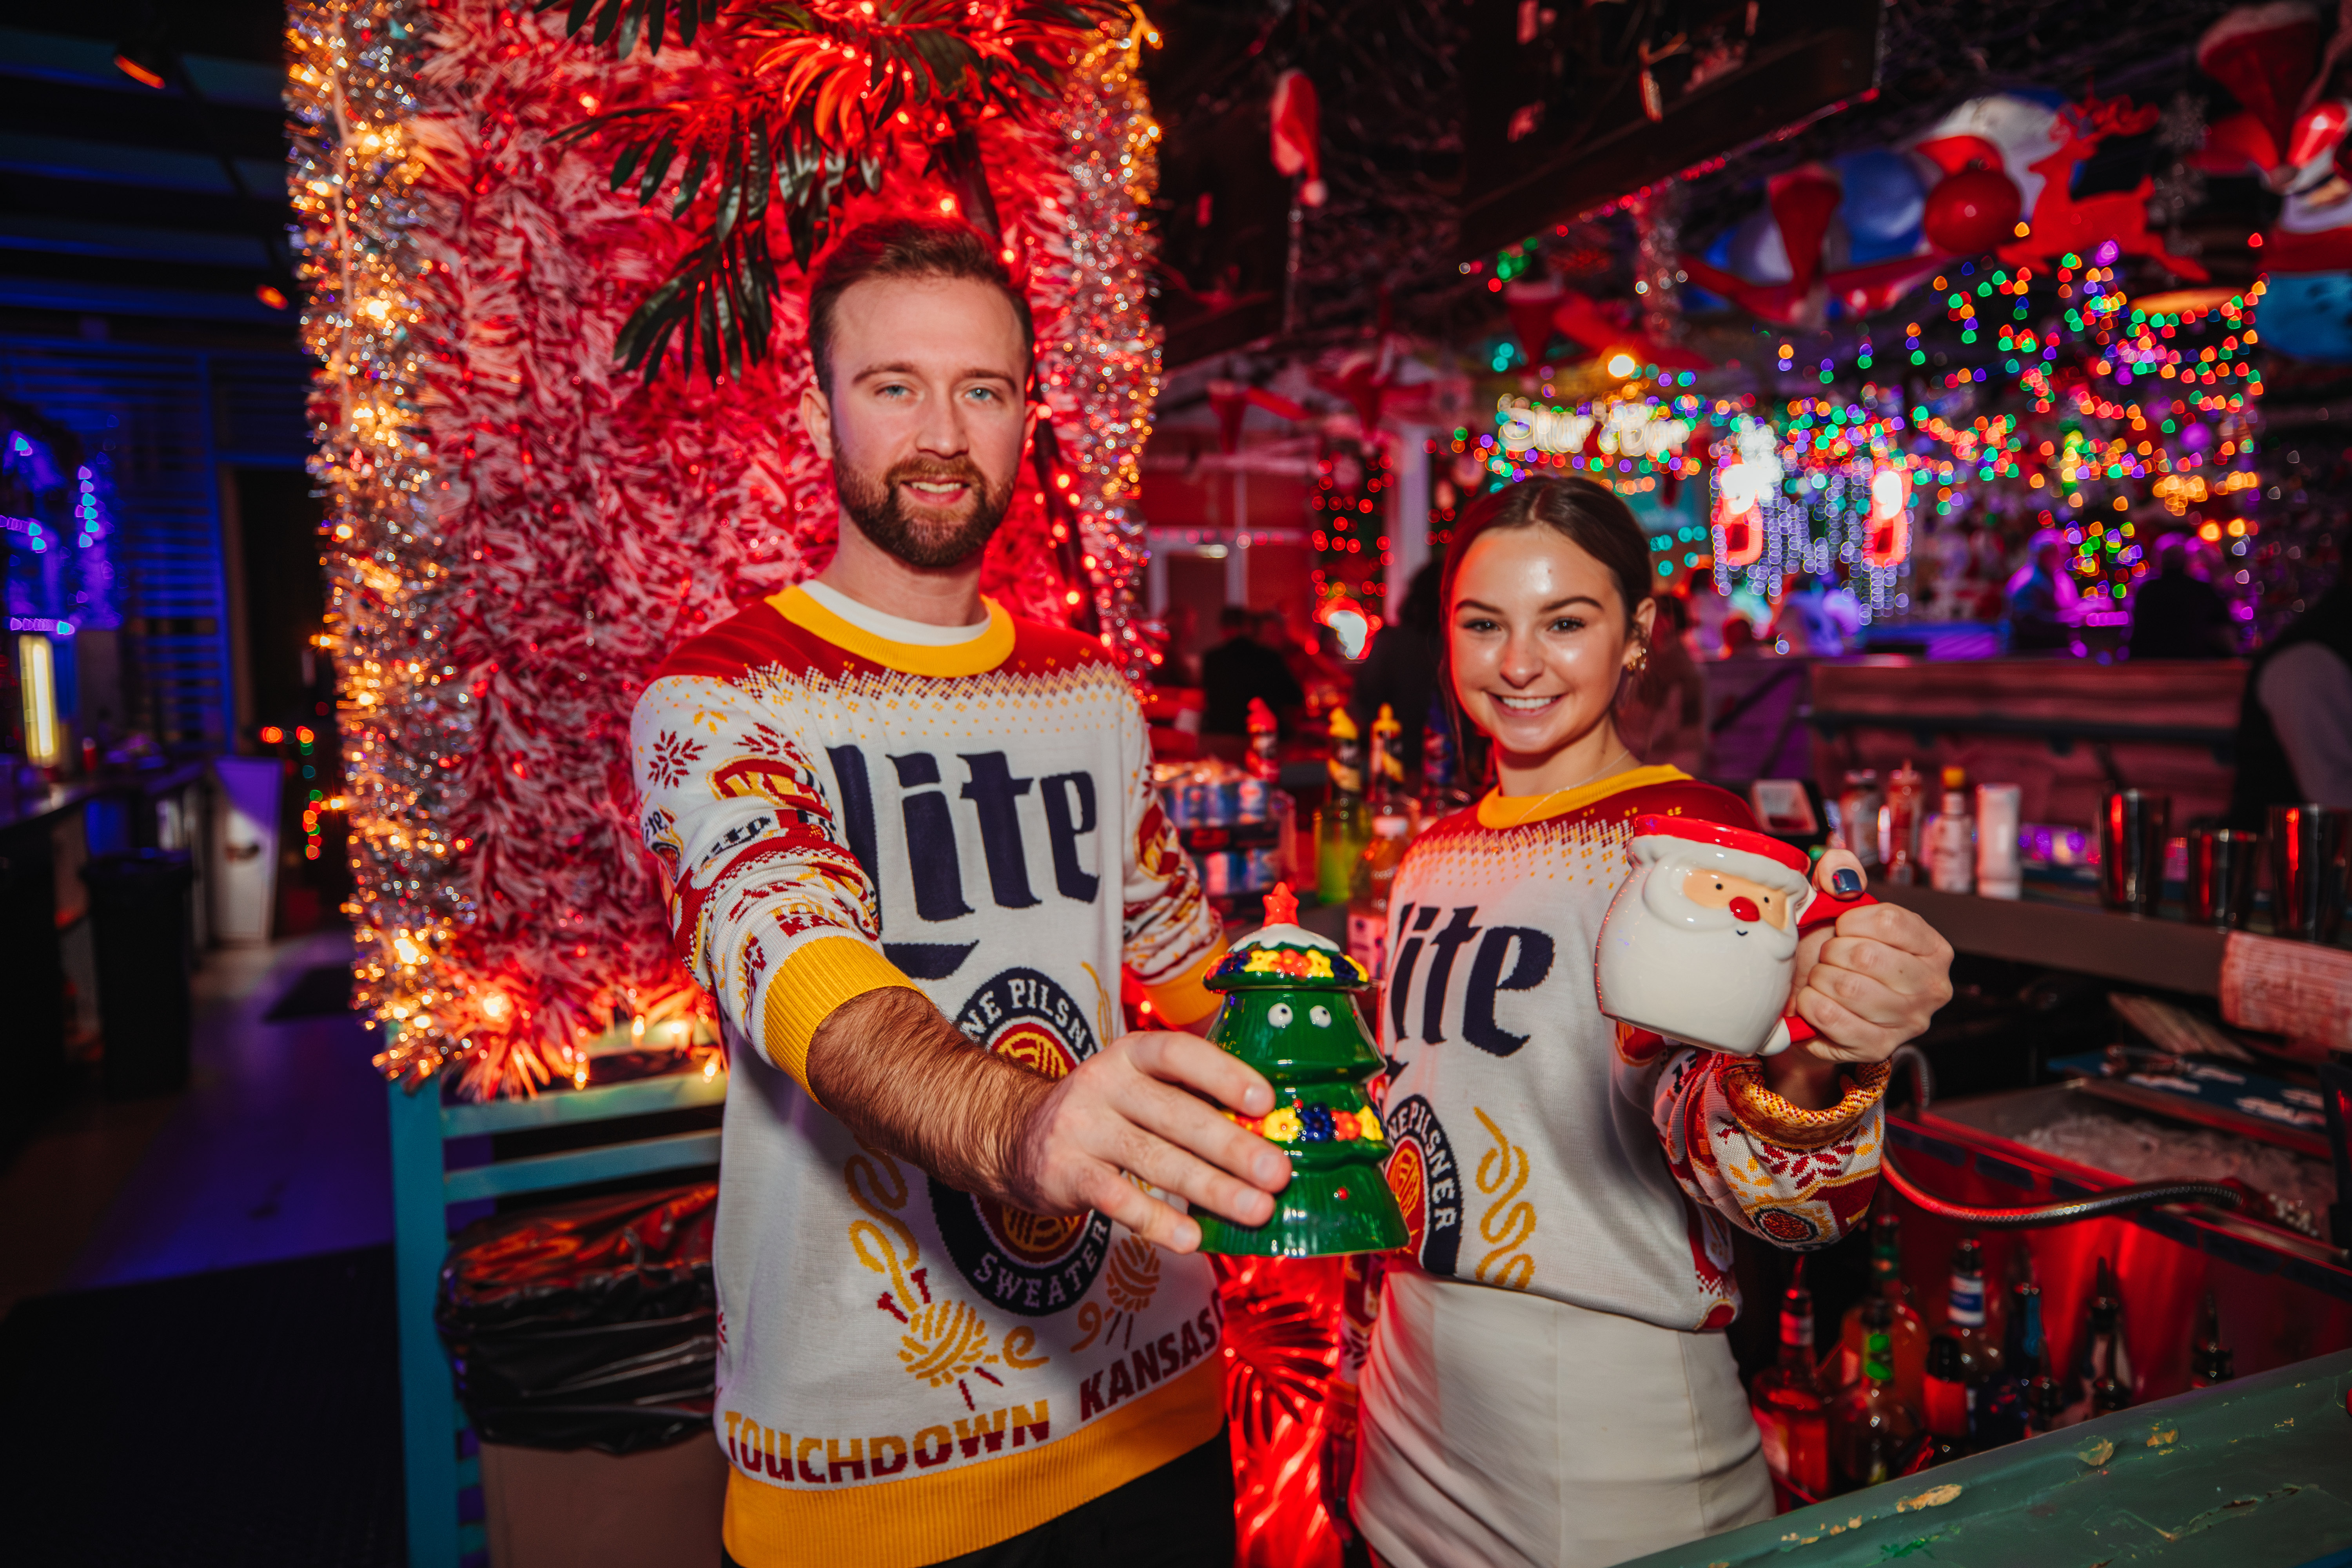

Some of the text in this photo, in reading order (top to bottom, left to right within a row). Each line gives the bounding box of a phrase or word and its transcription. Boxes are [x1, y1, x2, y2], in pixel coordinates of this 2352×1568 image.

[1008, 978, 1095, 1059] PILSN
[1408, 1101, 1457, 1231] PILSNER
[973, 1220, 1108, 1308] SWEATER
[724, 1399, 1050, 1484] TOUCHDOWN
[1080, 1306, 1218, 1422] KANSAS
